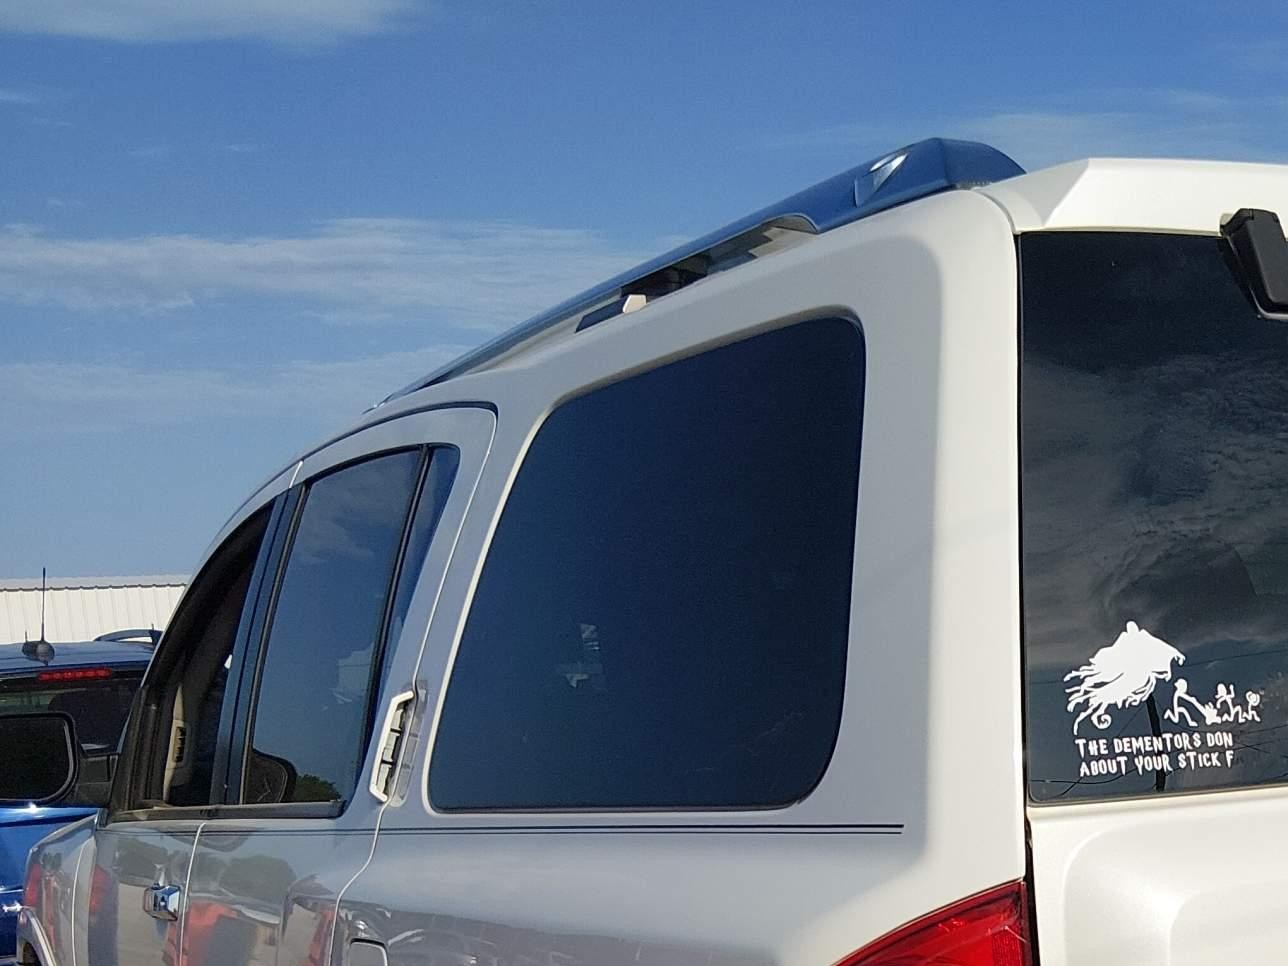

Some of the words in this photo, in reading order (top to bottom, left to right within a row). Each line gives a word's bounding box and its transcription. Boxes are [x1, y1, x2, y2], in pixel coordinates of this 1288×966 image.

[1075, 737, 1108, 758] THE
[1114, 732, 1201, 755] DEMENTORS
[1080, 756, 1127, 777] ABOUT
[1135, 753, 1172, 775] YOUR
[1179, 751, 1221, 769] STICK
